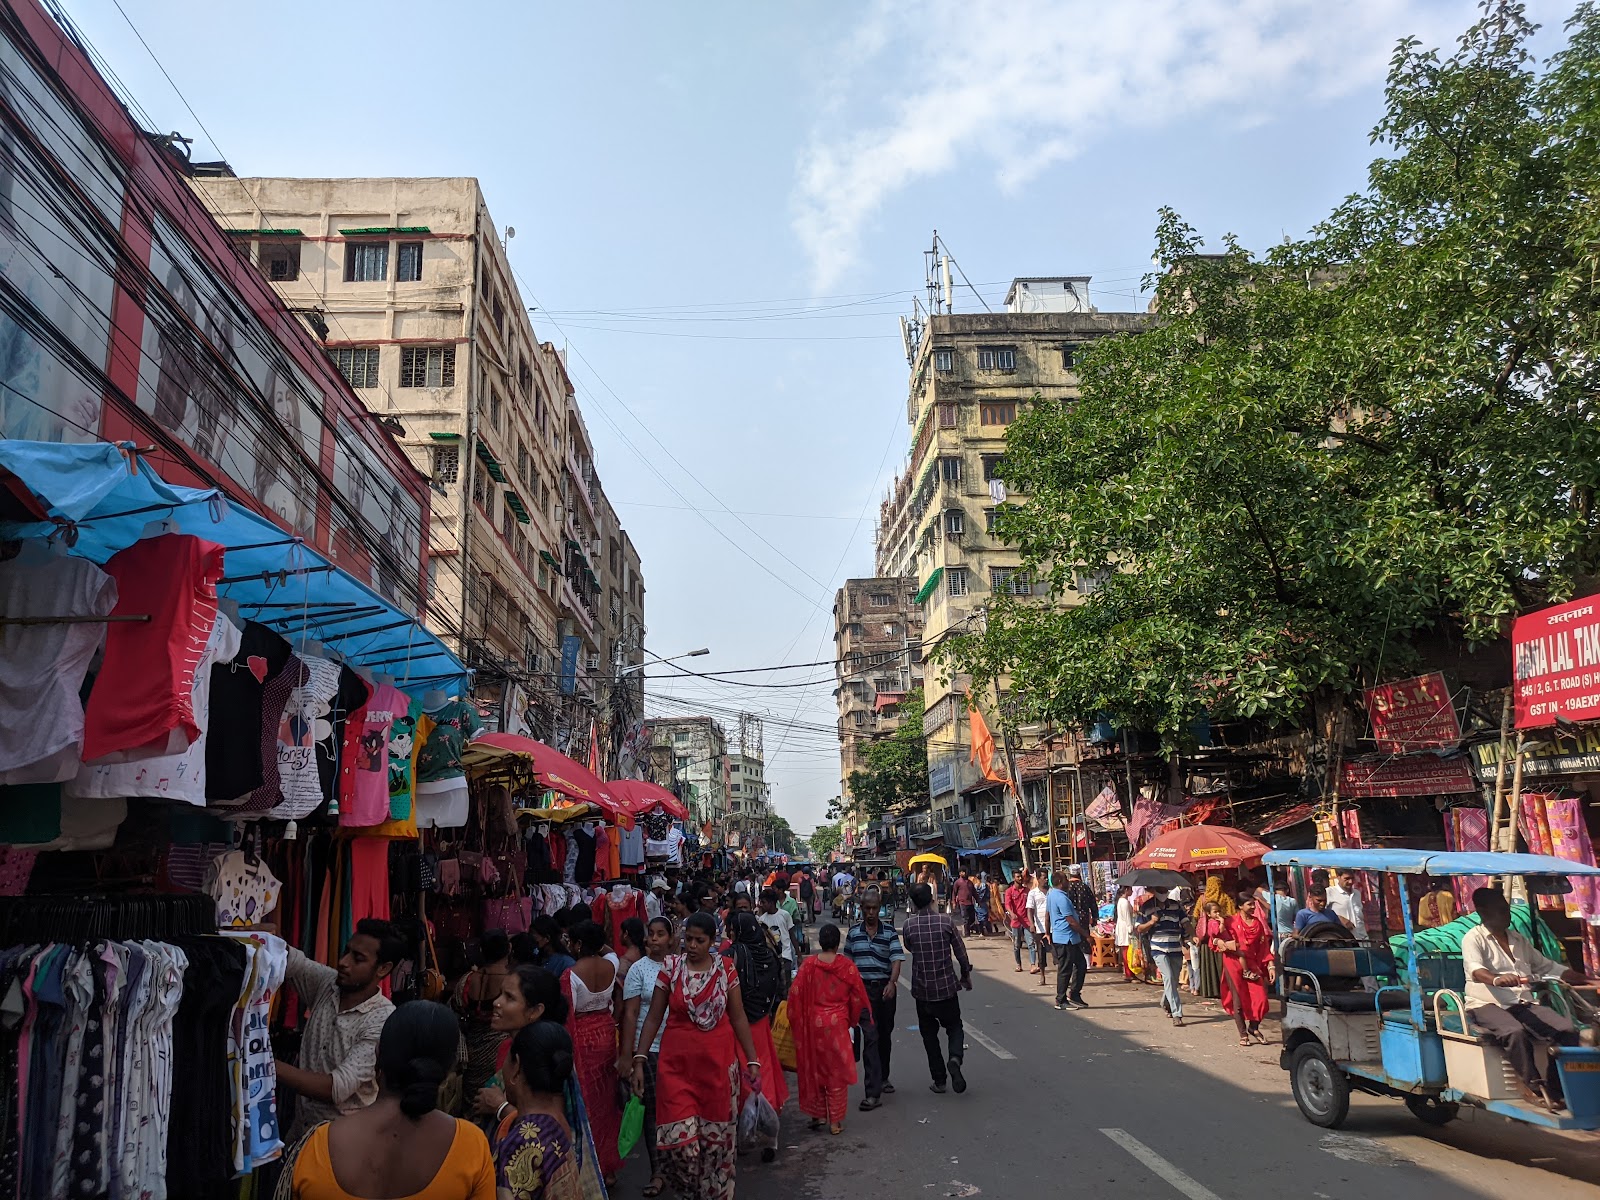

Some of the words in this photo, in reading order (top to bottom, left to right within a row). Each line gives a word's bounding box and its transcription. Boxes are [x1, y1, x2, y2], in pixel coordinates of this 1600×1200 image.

[1549, 630, 1574, 673] LAL
[1521, 685, 1533, 698] 545
[1545, 682, 1552, 693] G.
[1553, 680, 1560, 691] T.
[1561, 676, 1580, 690] ROAD
[1582, 673, 1592, 689] (S)
[365, 710, 393, 723] JERRY
[1530, 703, 1546, 716] GST
[1549, 701, 1558, 713] IN
[1565, 694, 1600, 711] 19AEXP
[276, 746, 311, 771] Honey
[1393, 771, 1429, 780] BLANKET
[1430, 768, 1463, 777] COVER
